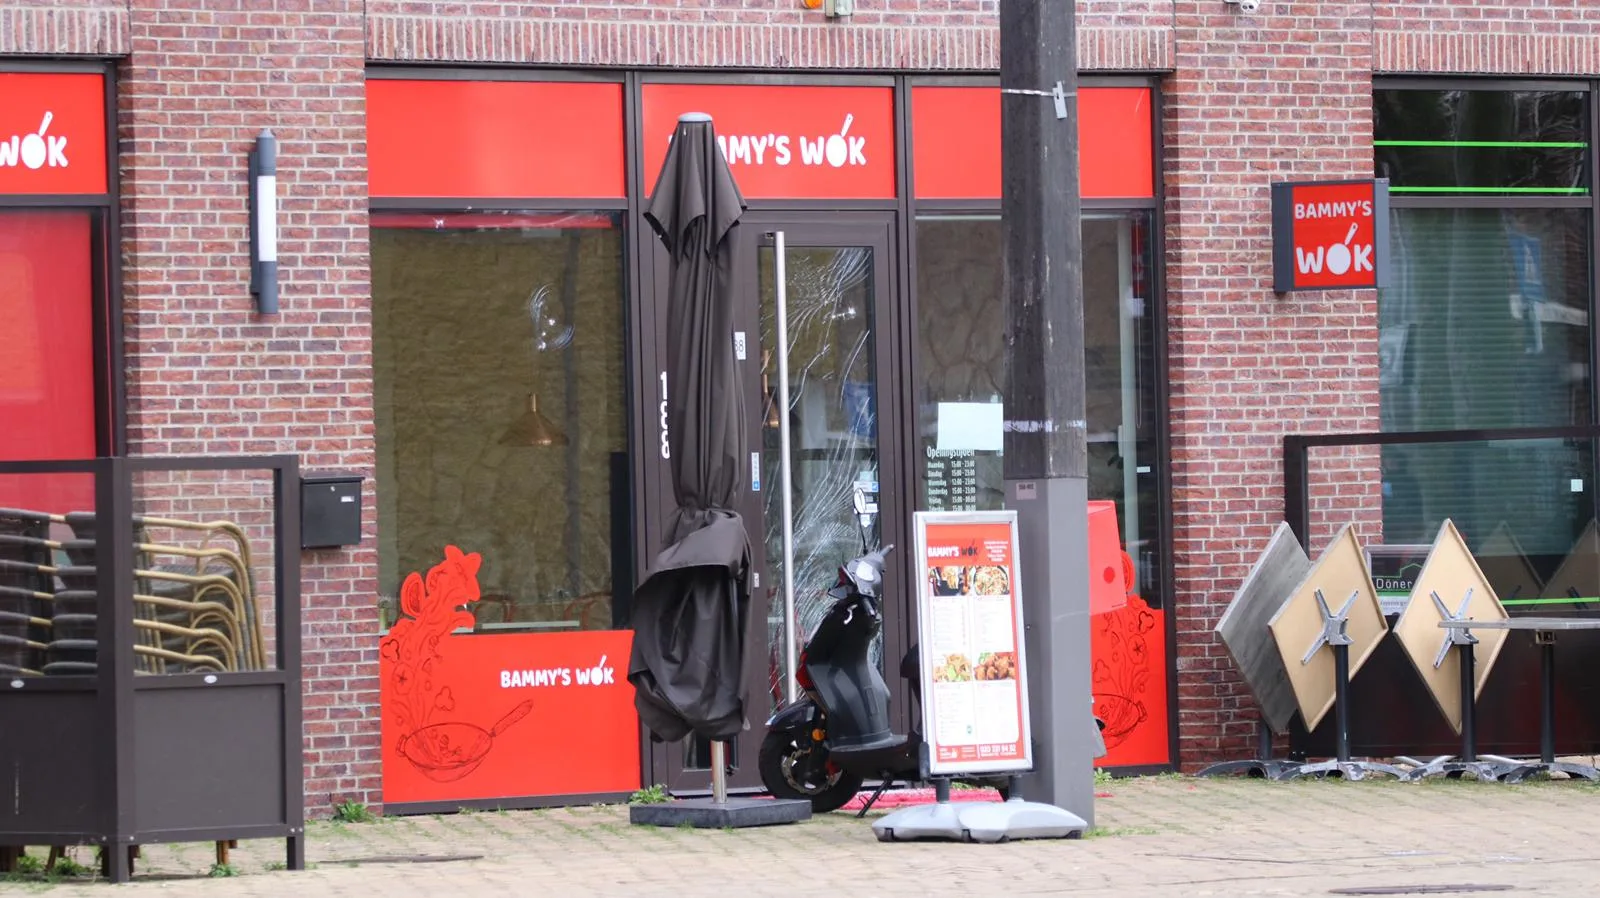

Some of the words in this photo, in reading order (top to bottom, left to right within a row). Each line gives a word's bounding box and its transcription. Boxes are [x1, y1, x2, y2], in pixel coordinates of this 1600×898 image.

[800, 113, 867, 167] WOK
[1294, 200, 1373, 219] BAMMY'S
[1296, 222, 1374, 275] WOK
[1376, 578, 1413, 589] Döner
[500, 667, 572, 688] BAMMY'S
[575, 654, 615, 686] WOK
